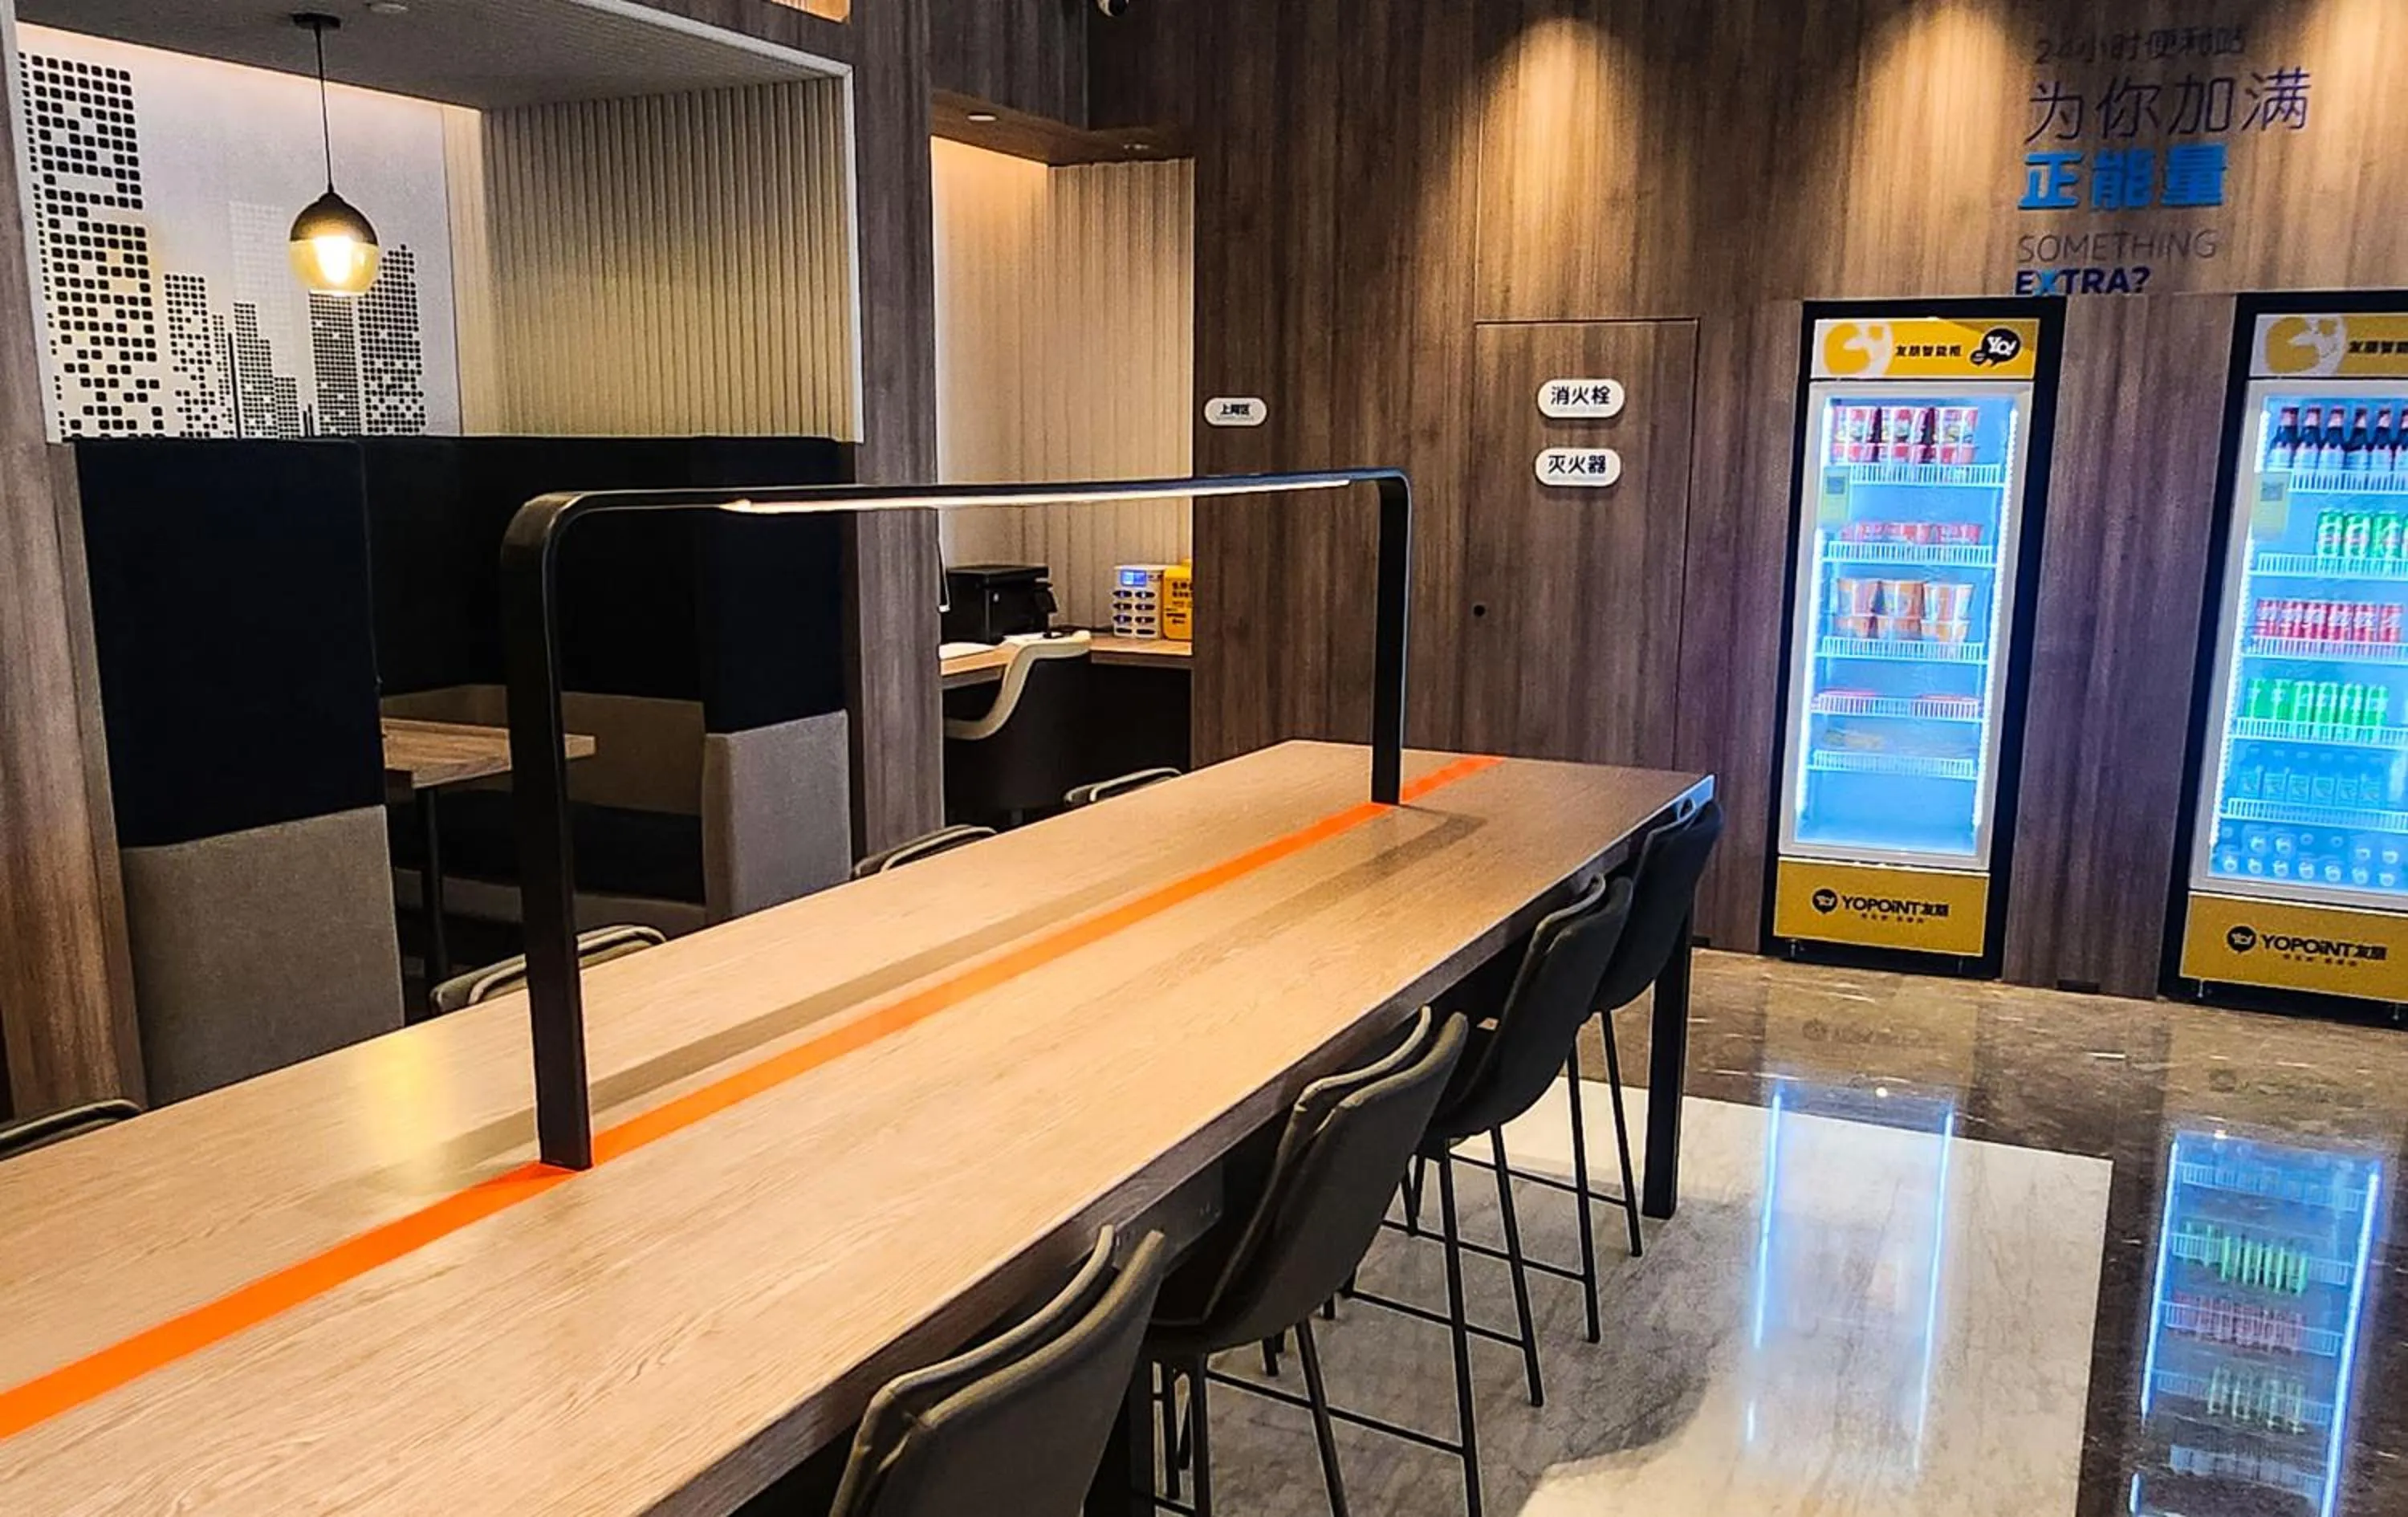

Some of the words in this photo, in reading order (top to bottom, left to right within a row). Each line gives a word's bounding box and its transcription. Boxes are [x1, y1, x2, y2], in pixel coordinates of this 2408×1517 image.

[2024, 66, 2312, 144] 为你加满
[2017, 143, 2228, 210] 正能量
[2018, 230, 2218, 263] SOMETHING
[2015, 267, 2150, 295] EXTRA?
[1550, 384, 1611, 405] 消火栓
[1548, 454, 1606, 474] 灭火器
